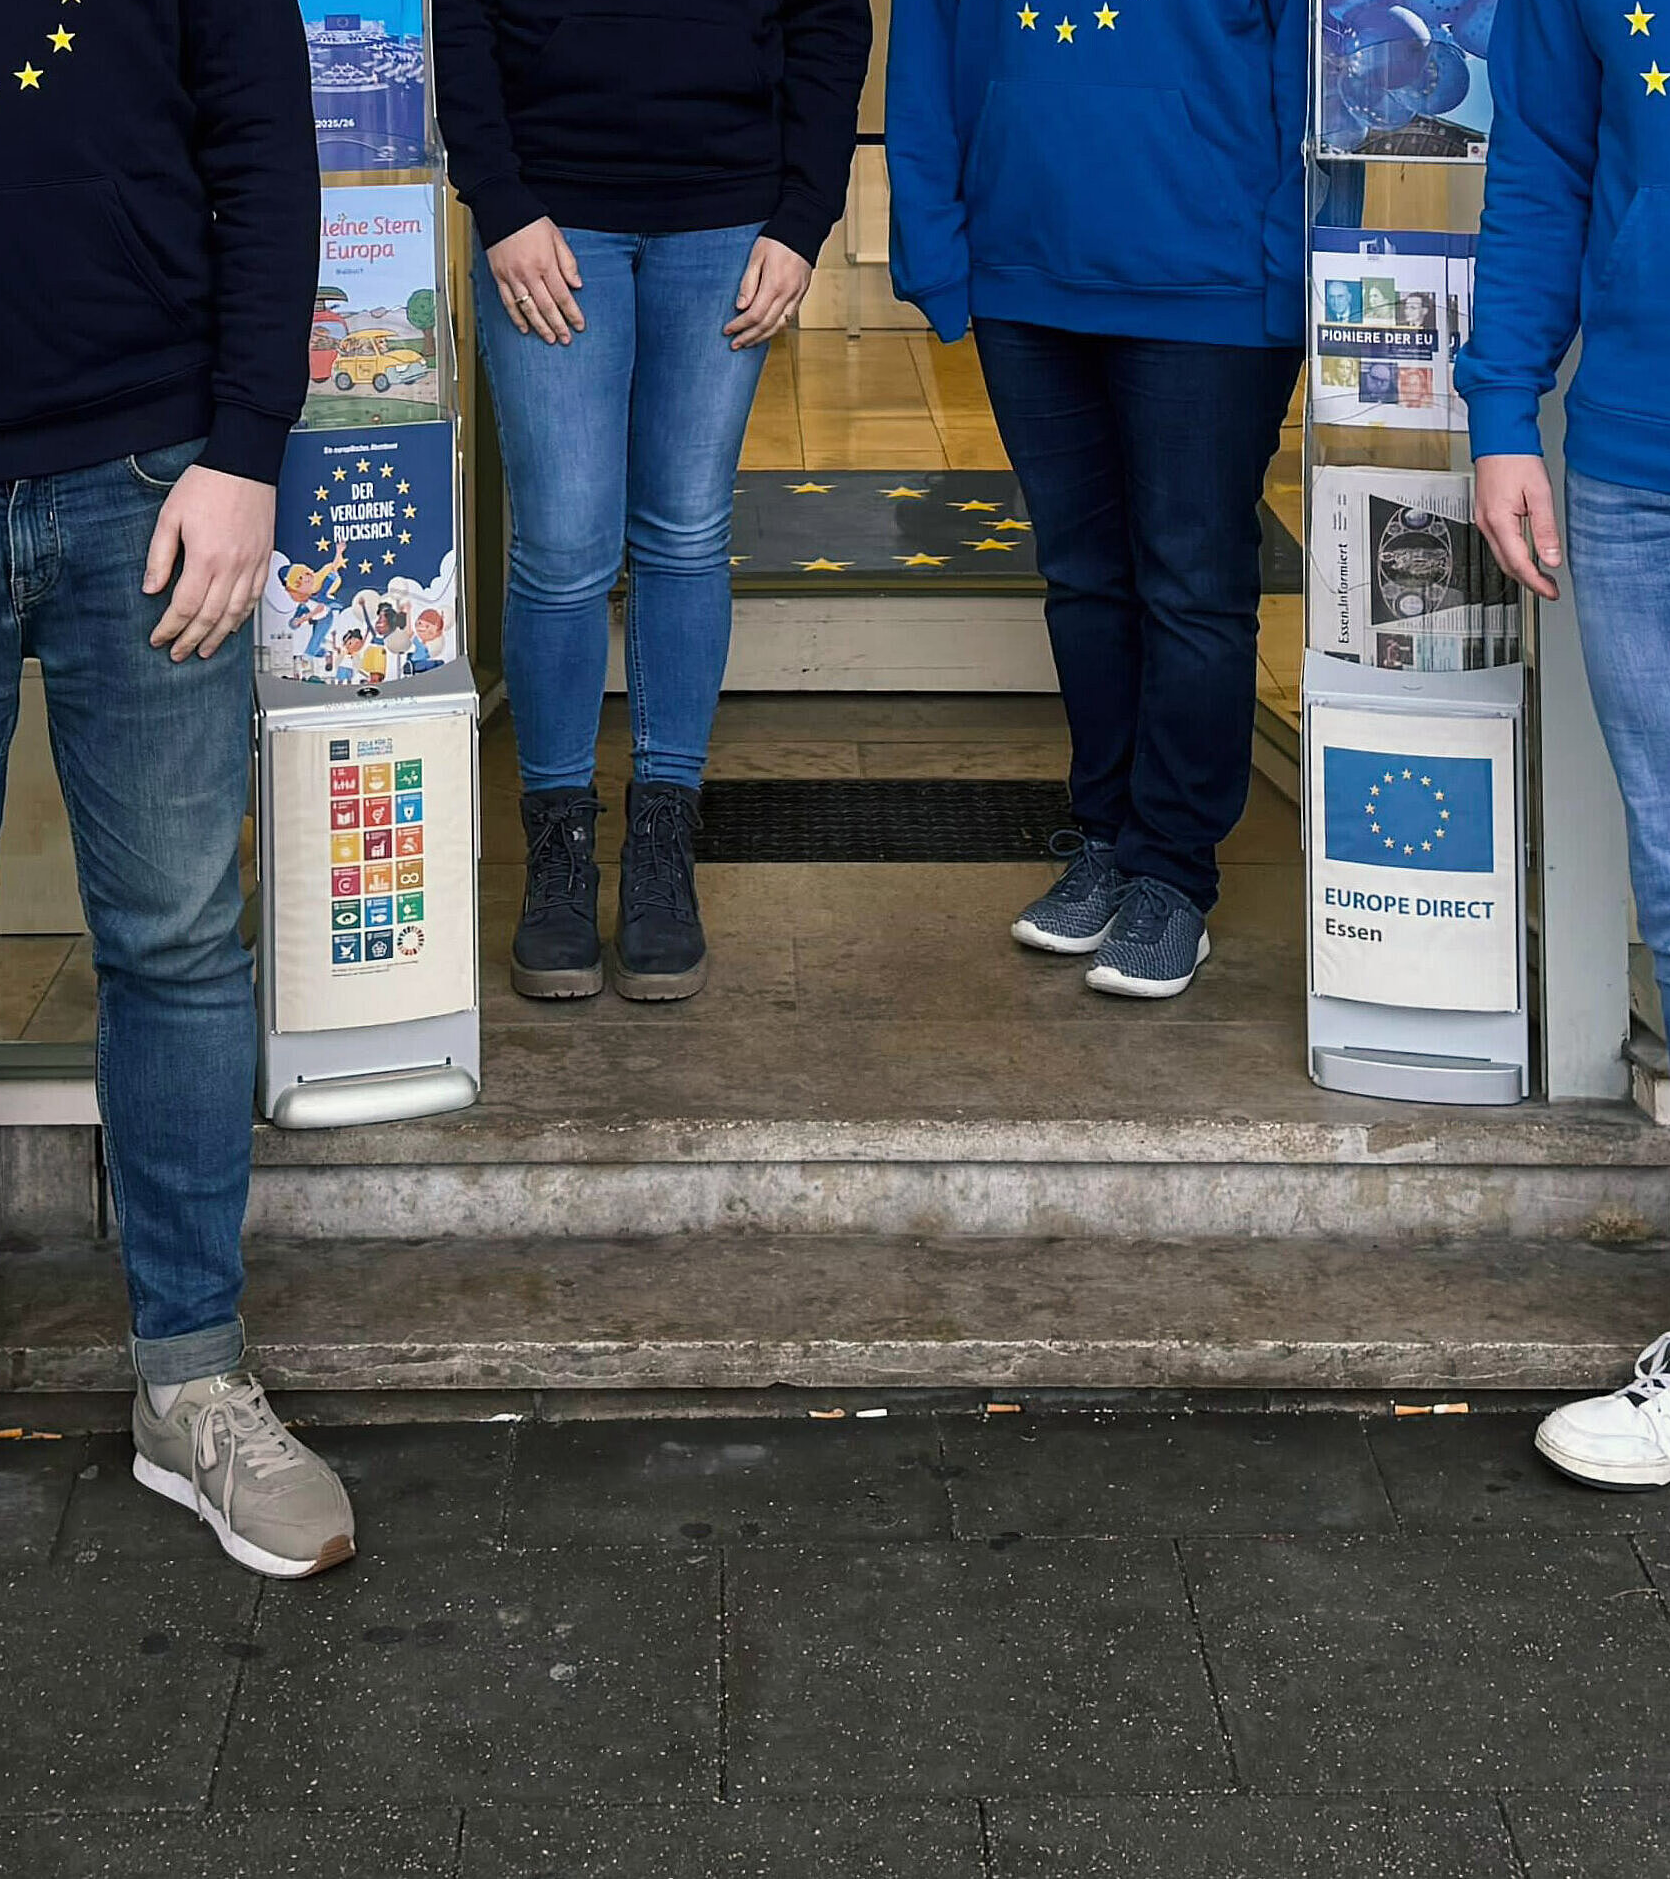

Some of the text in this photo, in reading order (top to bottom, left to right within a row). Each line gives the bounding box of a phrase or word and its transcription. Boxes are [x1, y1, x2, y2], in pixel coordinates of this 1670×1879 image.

[322, 216, 369, 237] leine
[327, 240, 395, 265] Europa
[1321, 328, 1433, 346] PIONIERE DER EU
[351, 482, 375, 500] DER
[329, 500, 397, 522] VERLORENE
[332, 520, 394, 543] RUCKSACK
[1325, 887, 1494, 920] EUROPE DIRECT
[1325, 918, 1383, 943] Essen
